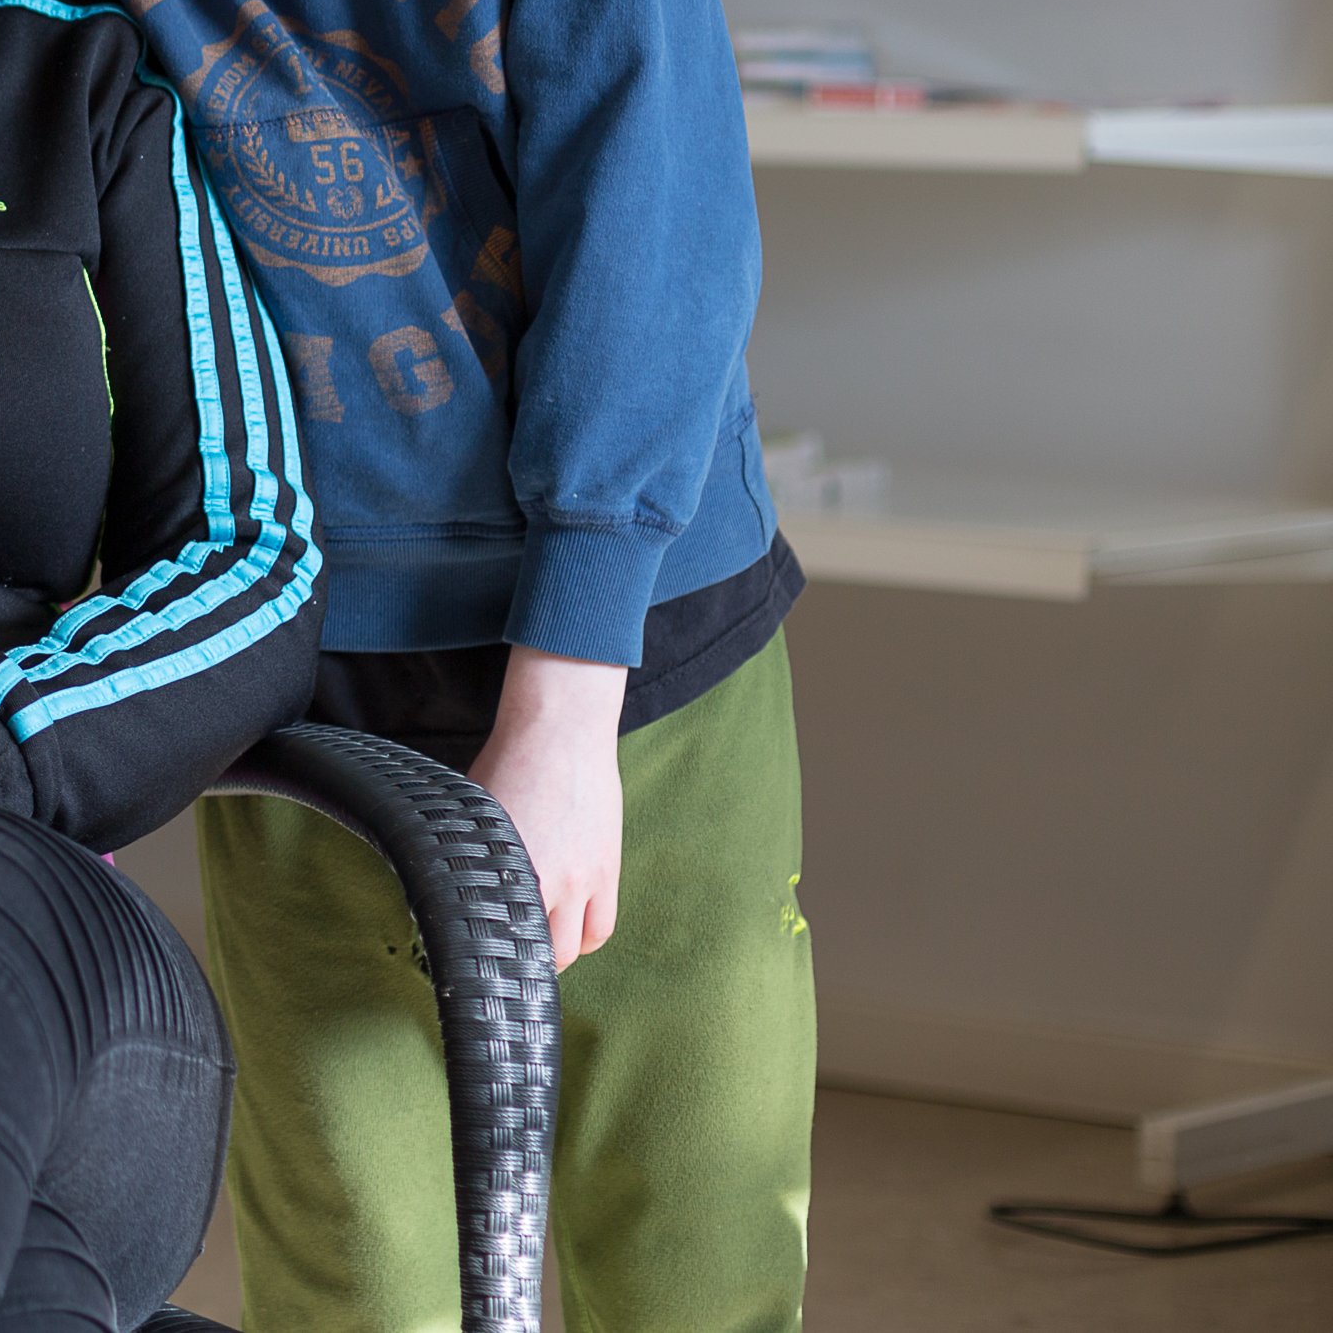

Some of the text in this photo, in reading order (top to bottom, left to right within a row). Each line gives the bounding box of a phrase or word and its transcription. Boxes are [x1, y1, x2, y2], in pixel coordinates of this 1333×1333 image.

[333, 57, 412, 148] NEVAA
[310, 141, 364, 184] 56
[222, 184, 371, 257] UNIVERSITY
